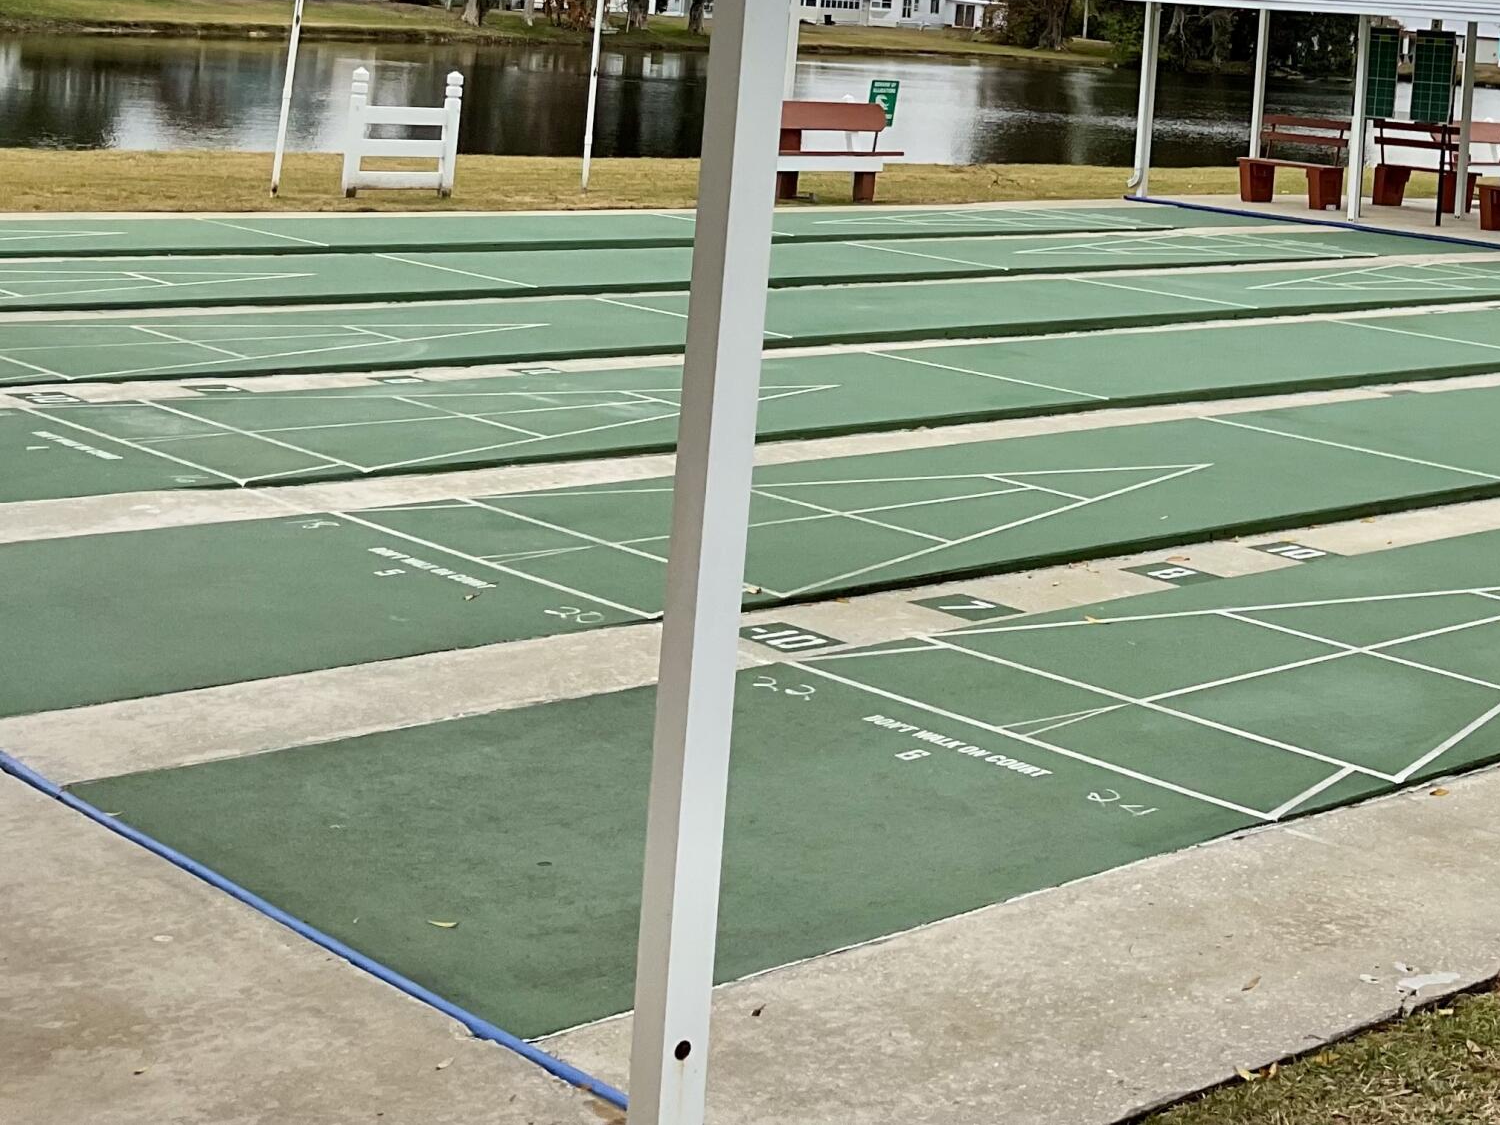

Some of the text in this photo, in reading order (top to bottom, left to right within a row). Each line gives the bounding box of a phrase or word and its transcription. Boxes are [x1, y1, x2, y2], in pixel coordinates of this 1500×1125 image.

[1265, 545, 1327, 560] 10
[1147, 566, 1198, 580] 8
[938, 599, 997, 610] 7
[894, 749, 932, 761] 6
[912, 729, 968, 749] WALK
[957, 745, 993, 757] ON
[984, 754, 1054, 777] COURT
